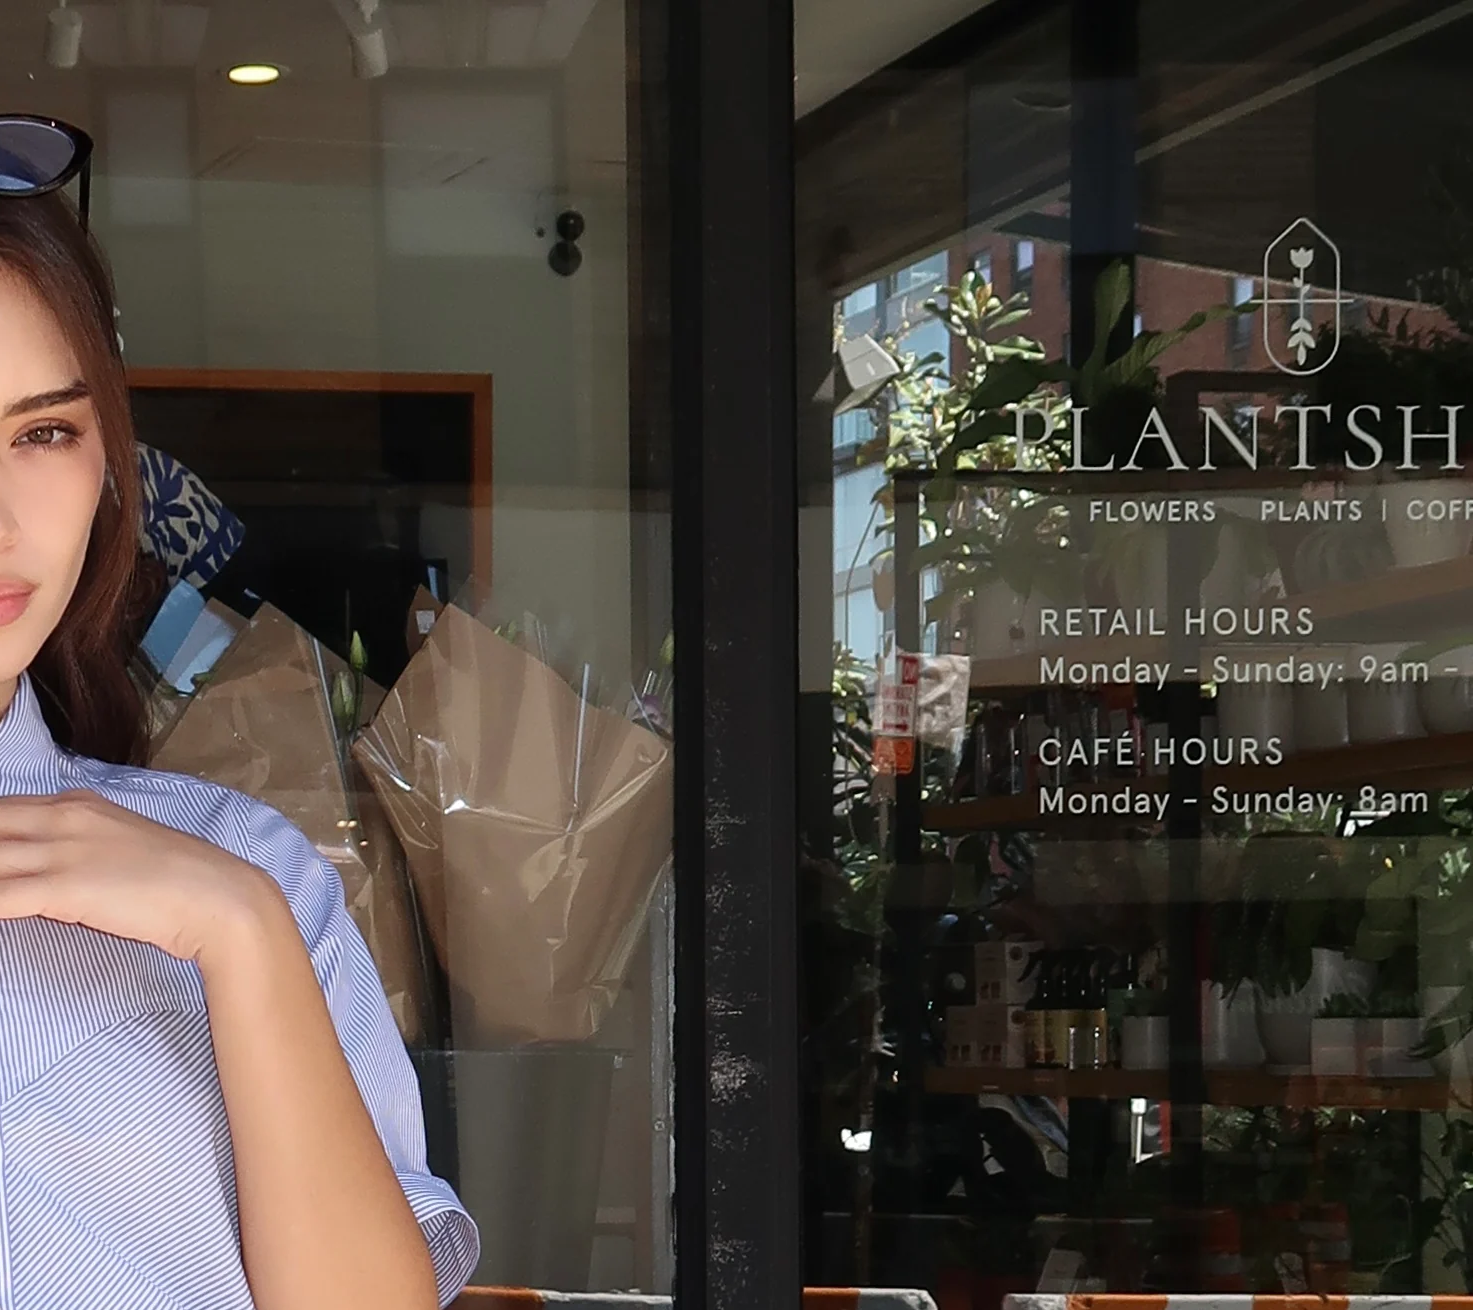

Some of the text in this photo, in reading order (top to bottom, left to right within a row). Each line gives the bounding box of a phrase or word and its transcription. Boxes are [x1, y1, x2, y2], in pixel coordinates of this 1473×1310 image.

[1011, 404, 1465, 471] PLANTSH
[1089, 500, 1216, 522] FLOWERS
[1261, 500, 1362, 522] PLANTS
[1040, 607, 1314, 636] RETAIL HOURS
[1040, 656, 1171, 689] Monday
[1212, 655, 1344, 690] Sunday:
[1360, 656, 1429, 683] 9am
[1039, 731, 1283, 767] CAFÉ HOURS
[1040, 786, 1171, 820] Monday
[1212, 785, 1344, 820] Sunday:
[1358, 785, 1428, 812] 8am
